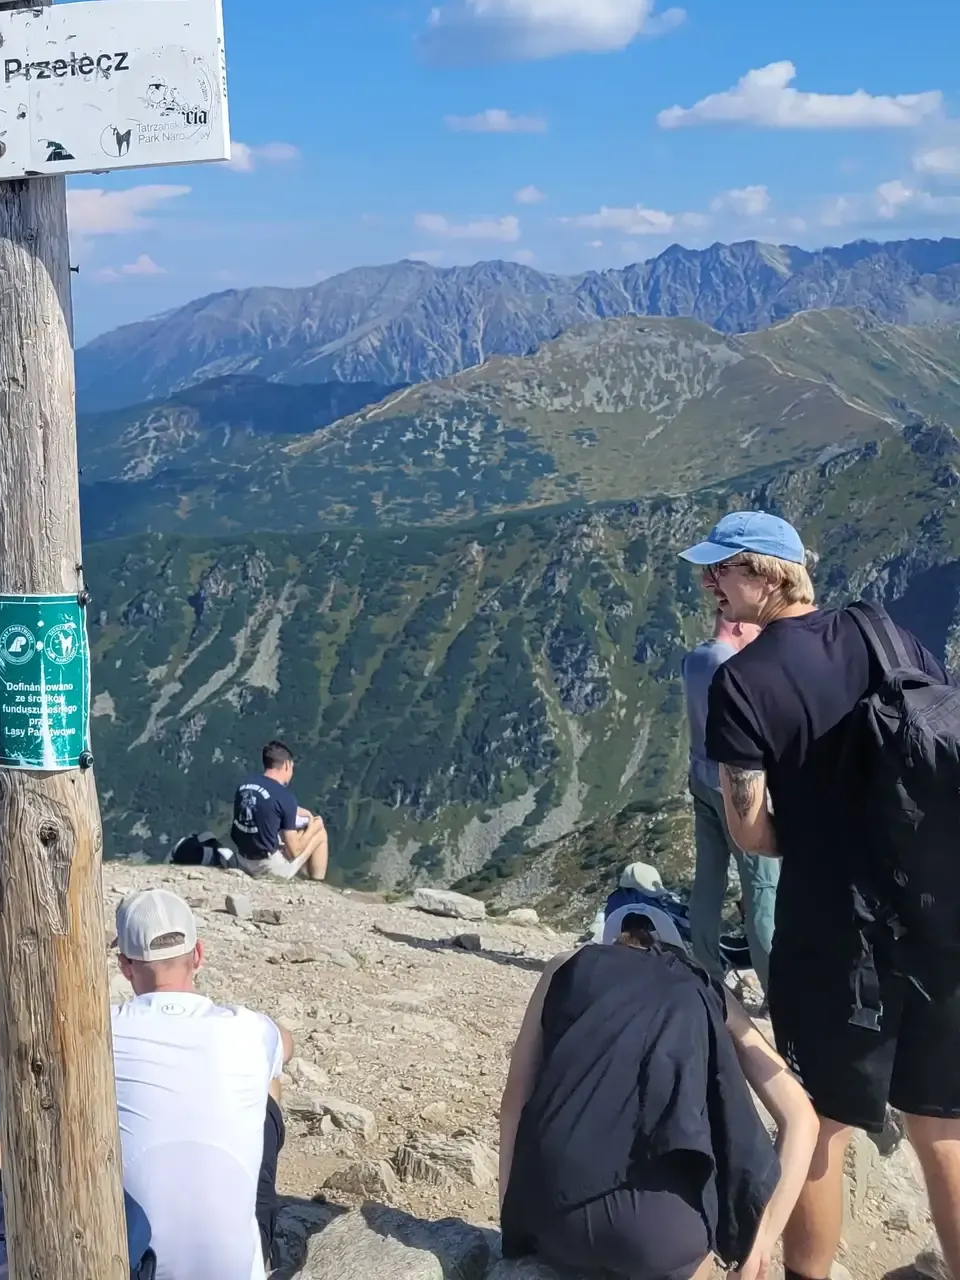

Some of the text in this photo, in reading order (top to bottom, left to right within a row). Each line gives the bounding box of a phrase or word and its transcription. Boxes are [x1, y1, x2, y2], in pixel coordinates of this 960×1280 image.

[138, 133, 160, 144] Park
[6, 682, 73, 692] Dofinanowano
[29, 718, 54, 727] przz
[5, 726, 26, 738] Lasy
